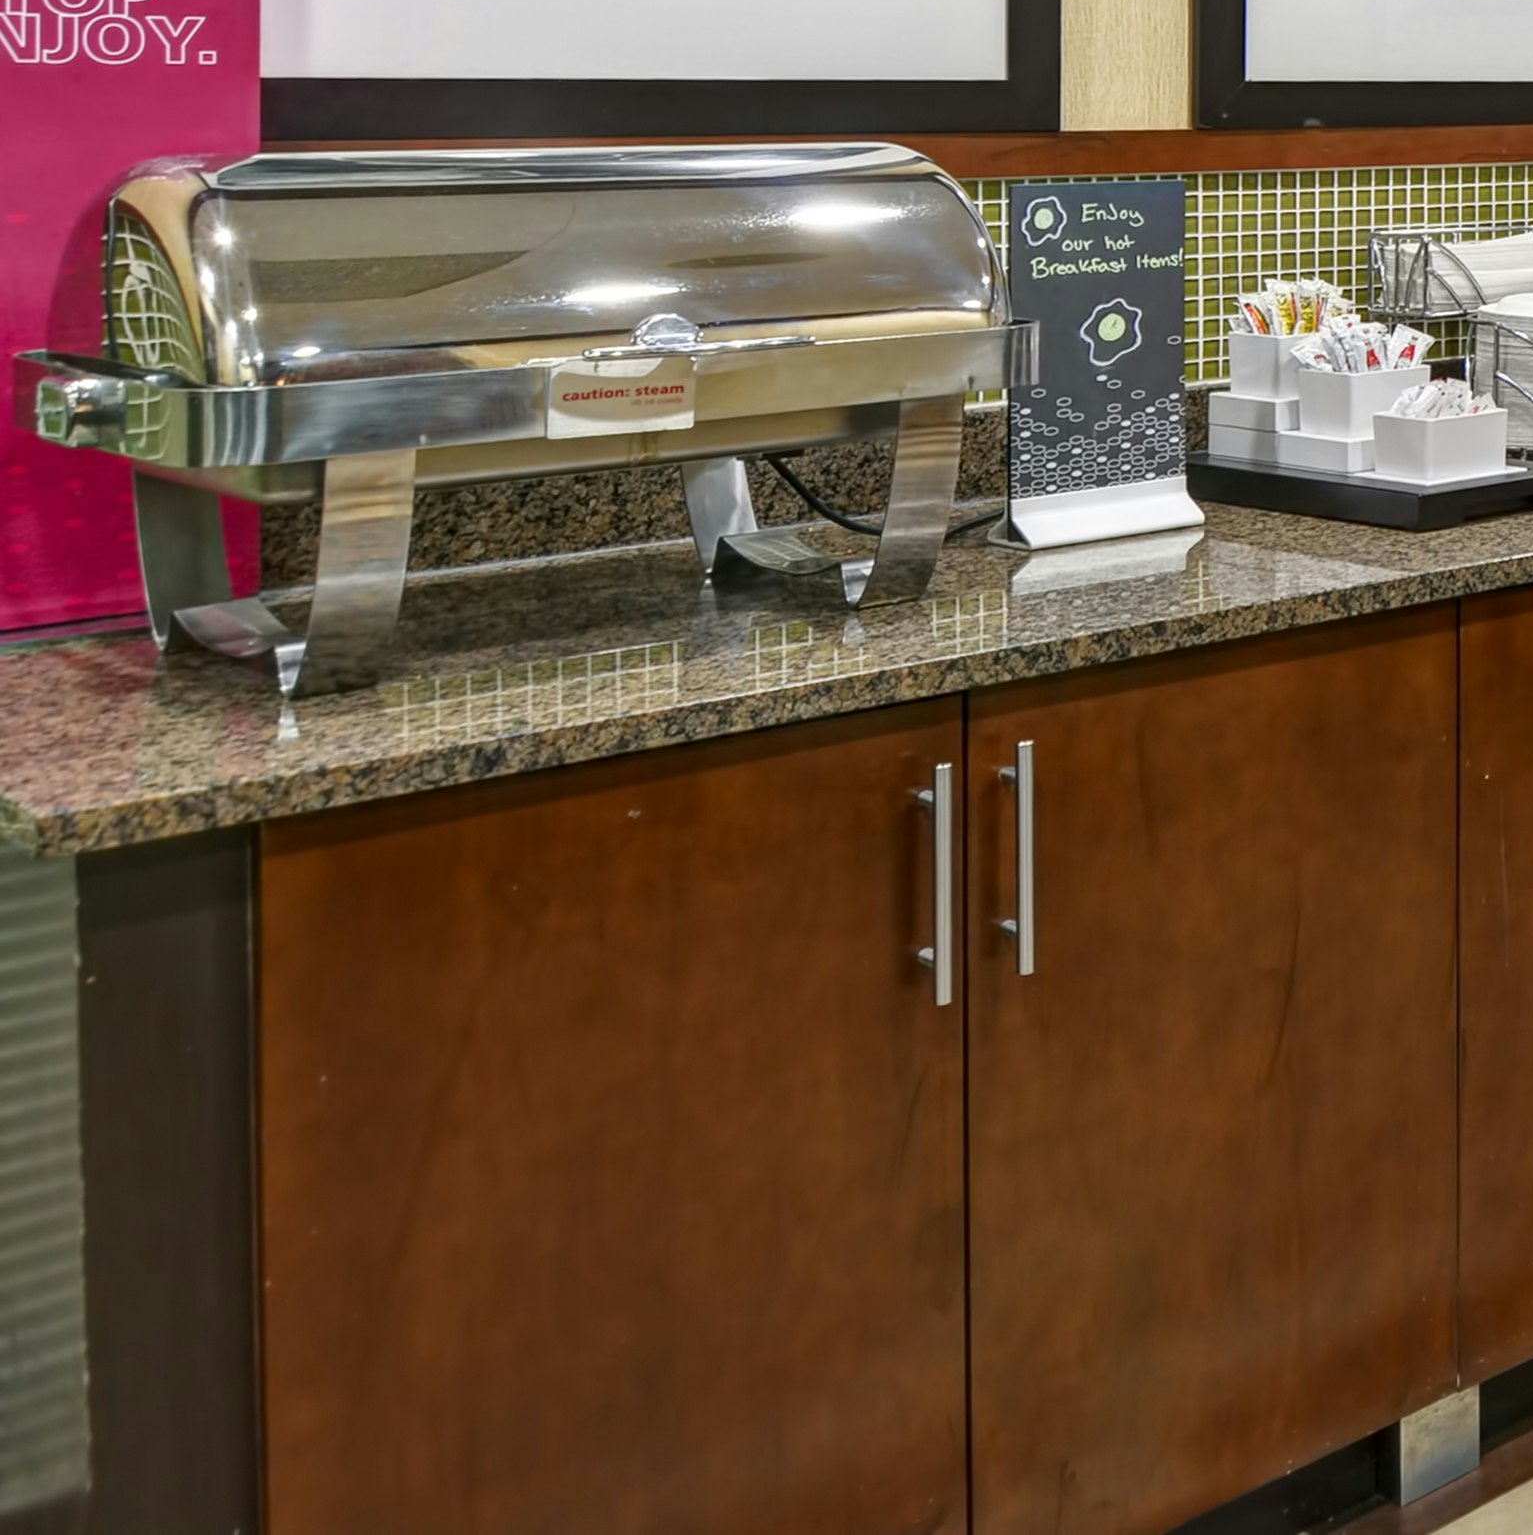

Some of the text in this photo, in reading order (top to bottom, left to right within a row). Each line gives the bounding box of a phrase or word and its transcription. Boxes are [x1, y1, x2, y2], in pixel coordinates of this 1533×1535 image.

[1061, 234, 1135, 252] our hot
[562, 388, 630, 402] caution:
[635, 384, 684, 397] steam
